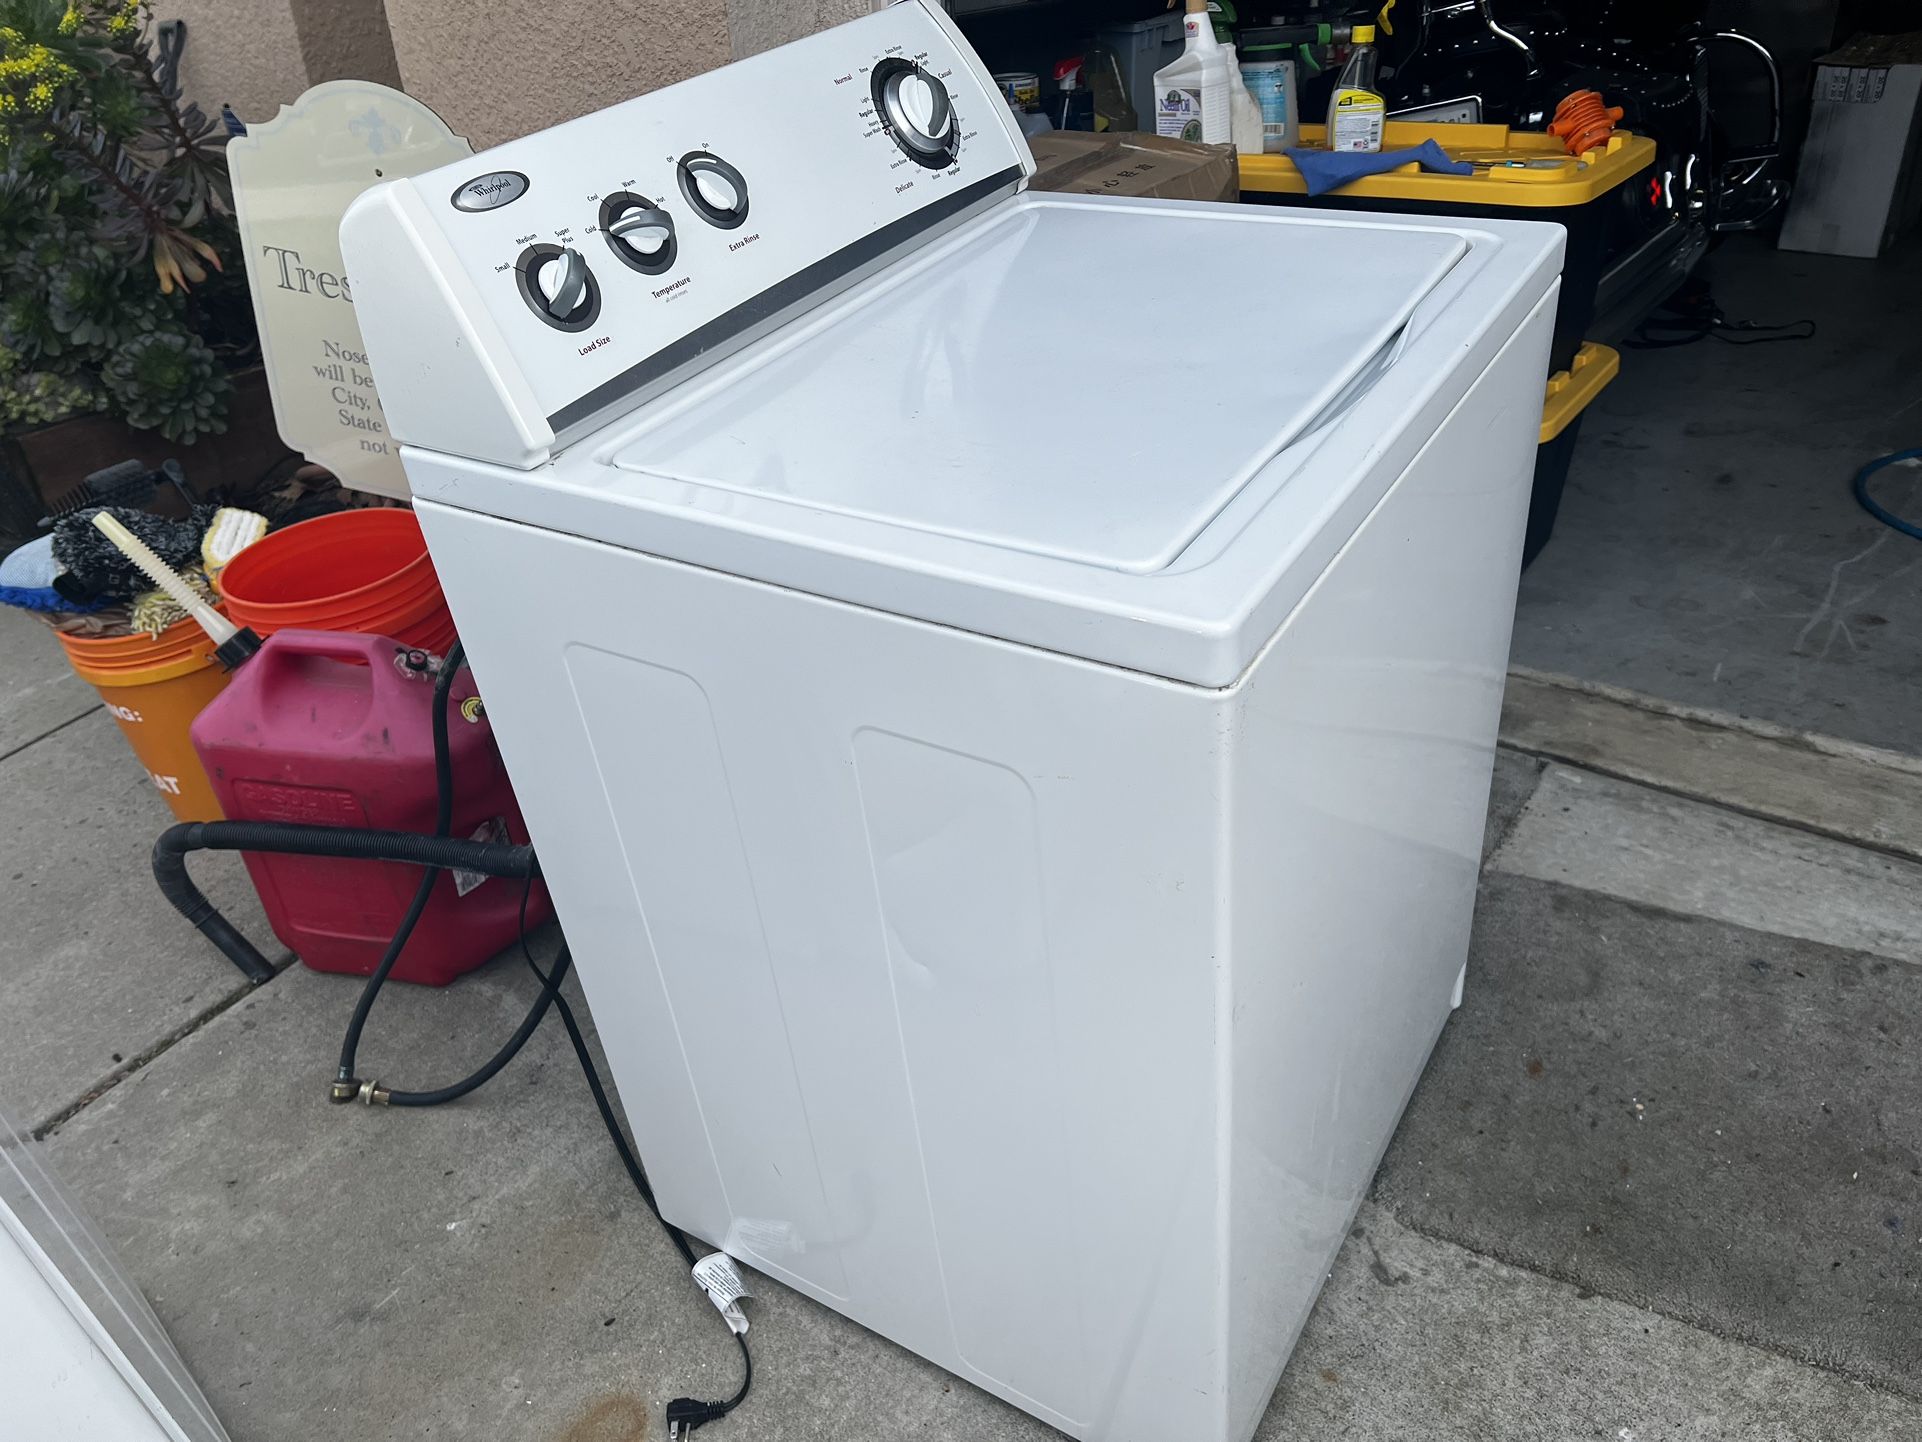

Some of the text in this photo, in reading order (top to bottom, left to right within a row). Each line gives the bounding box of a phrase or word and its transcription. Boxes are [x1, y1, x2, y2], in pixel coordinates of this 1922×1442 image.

[938, 68, 952, 79] Casual
[834, 74, 853, 86] Normal
[666, 155, 674, 163] Off
[474, 179, 511, 197] Whirlpool
[621, 179, 637, 188] Warm
[895, 181, 914, 194] Delicate
[586, 193, 599, 202] Cool
[554, 227, 570, 238] Super
[584, 225, 597, 235] Cold
[515, 233, 537, 245] Medium
[561, 235, 574, 244] Plus
[728, 233, 760, 252] Extra Rinse
[494, 262, 511, 274] Small
[652, 276, 691, 299] Temperature
[578, 336, 611, 356] Load Size
[312, 364, 374, 388] will be
[331, 386, 371, 411] City,
[339, 408, 382, 433] State
[360, 439, 389, 456] not
